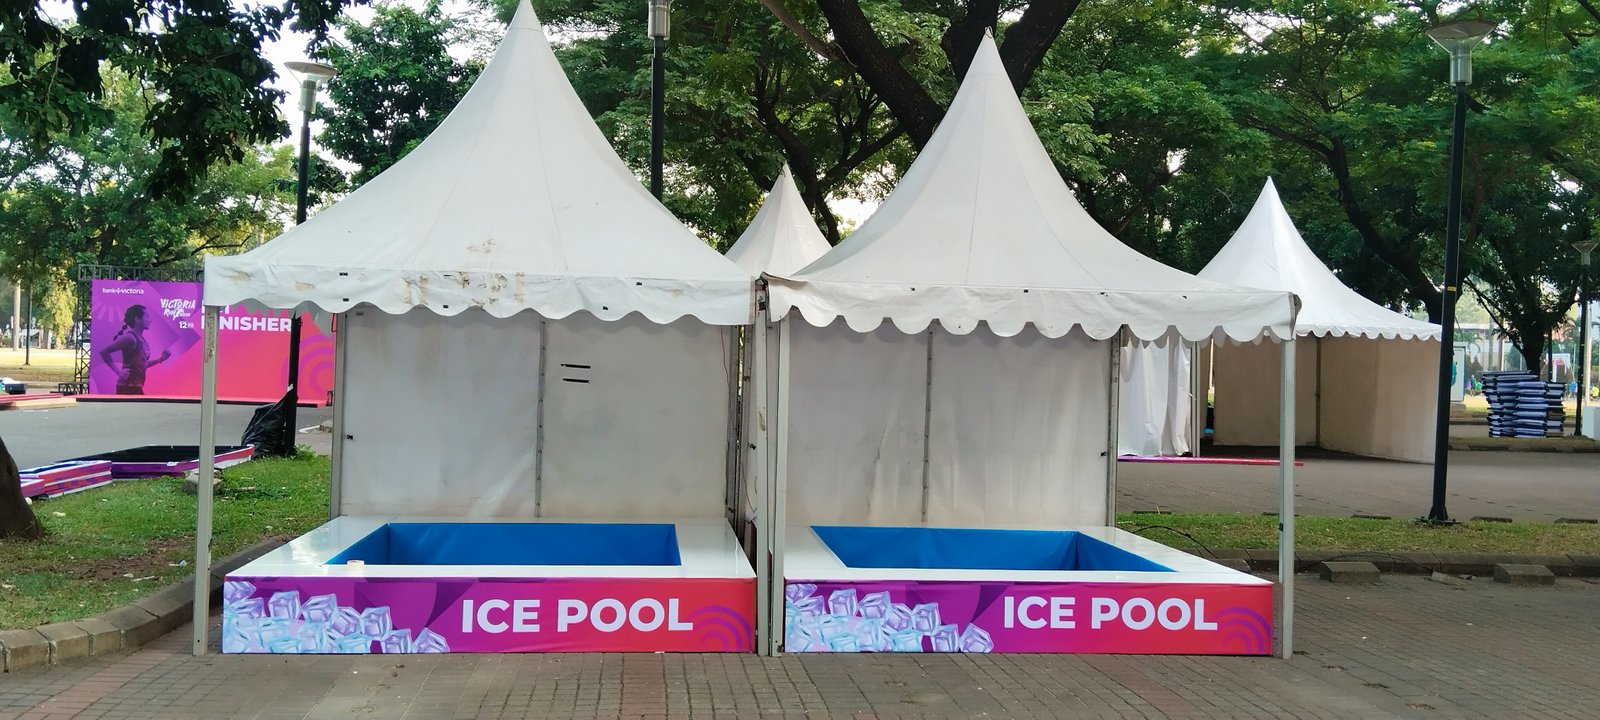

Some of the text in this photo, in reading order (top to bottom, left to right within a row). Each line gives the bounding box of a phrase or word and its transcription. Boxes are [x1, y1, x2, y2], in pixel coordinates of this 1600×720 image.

[179, 321, 188, 329] 12
[201, 316, 291, 332] NISHER
[461, 597, 694, 634] ICE POOL
[1003, 596, 1218, 631] ICE POOL
